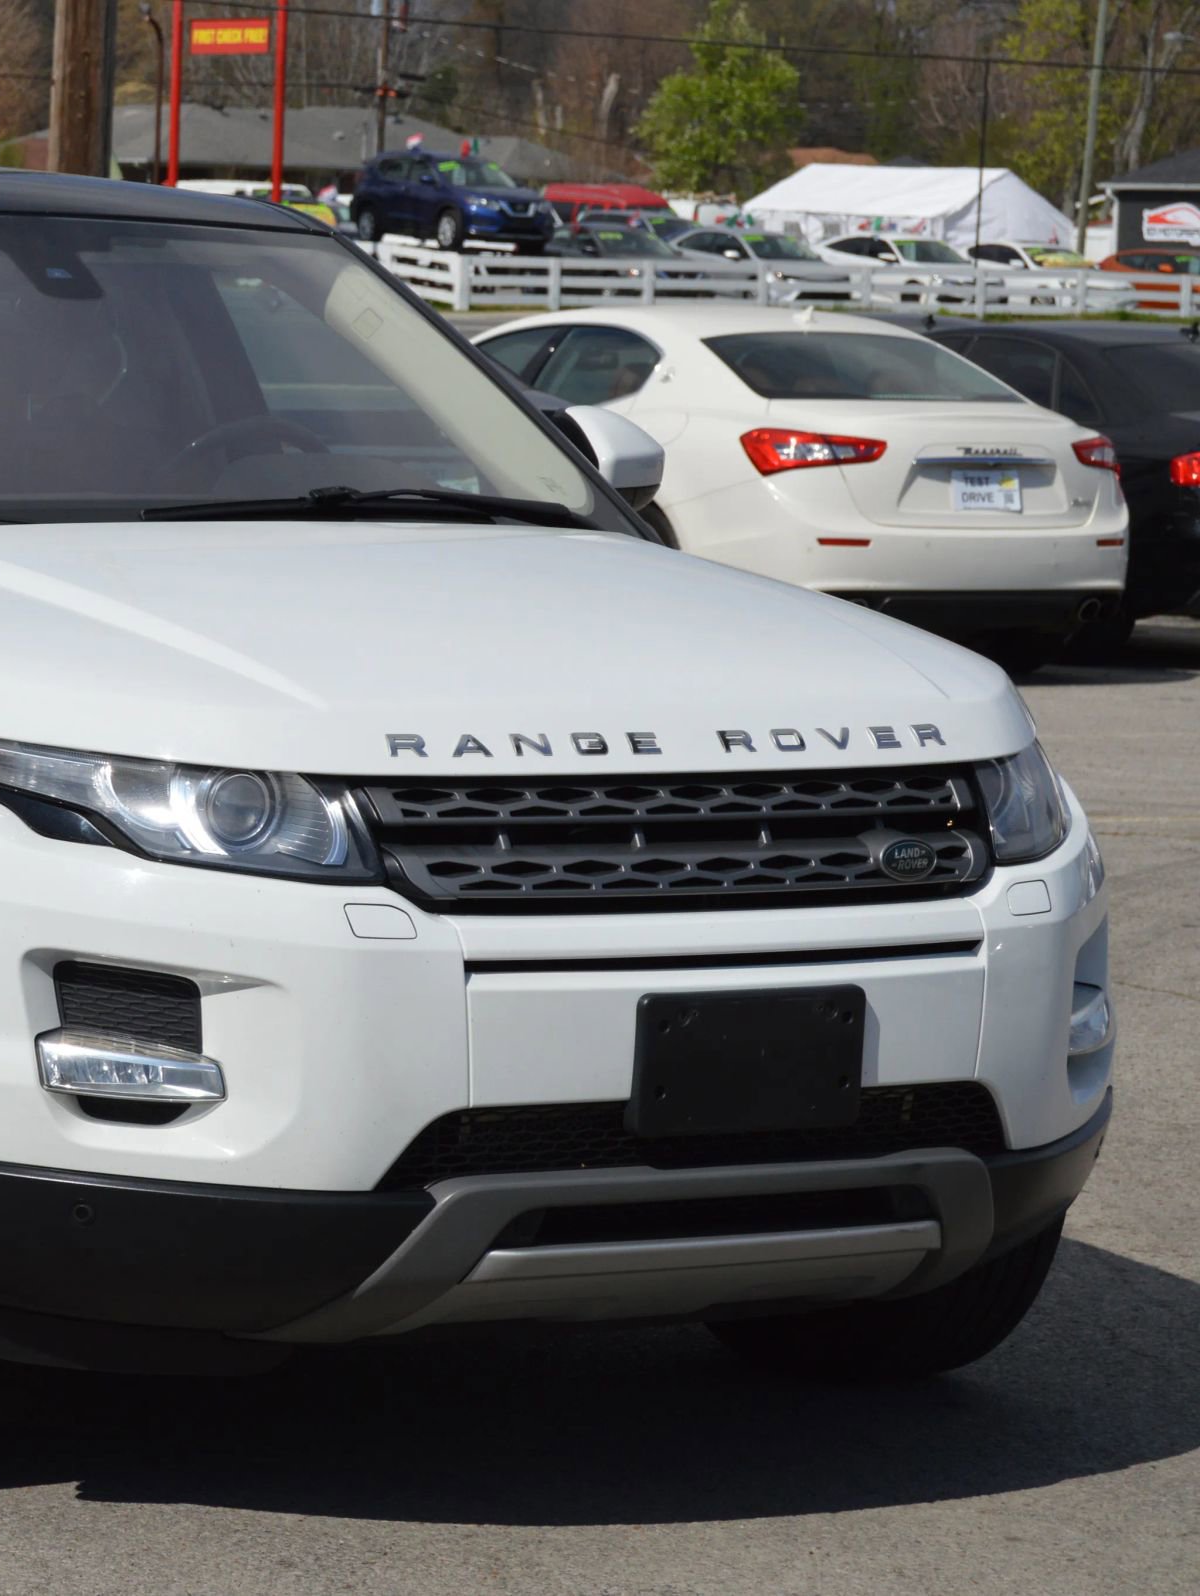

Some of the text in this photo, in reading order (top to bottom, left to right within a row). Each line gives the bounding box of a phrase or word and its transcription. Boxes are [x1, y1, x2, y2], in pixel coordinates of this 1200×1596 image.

[963, 476, 990, 487] TEST
[961, 492, 995, 503] DRIVE
[385, 723, 947, 758] RANGE ROVER
[894, 847, 920, 859] LAND
[897, 858, 929, 871] ROVER
